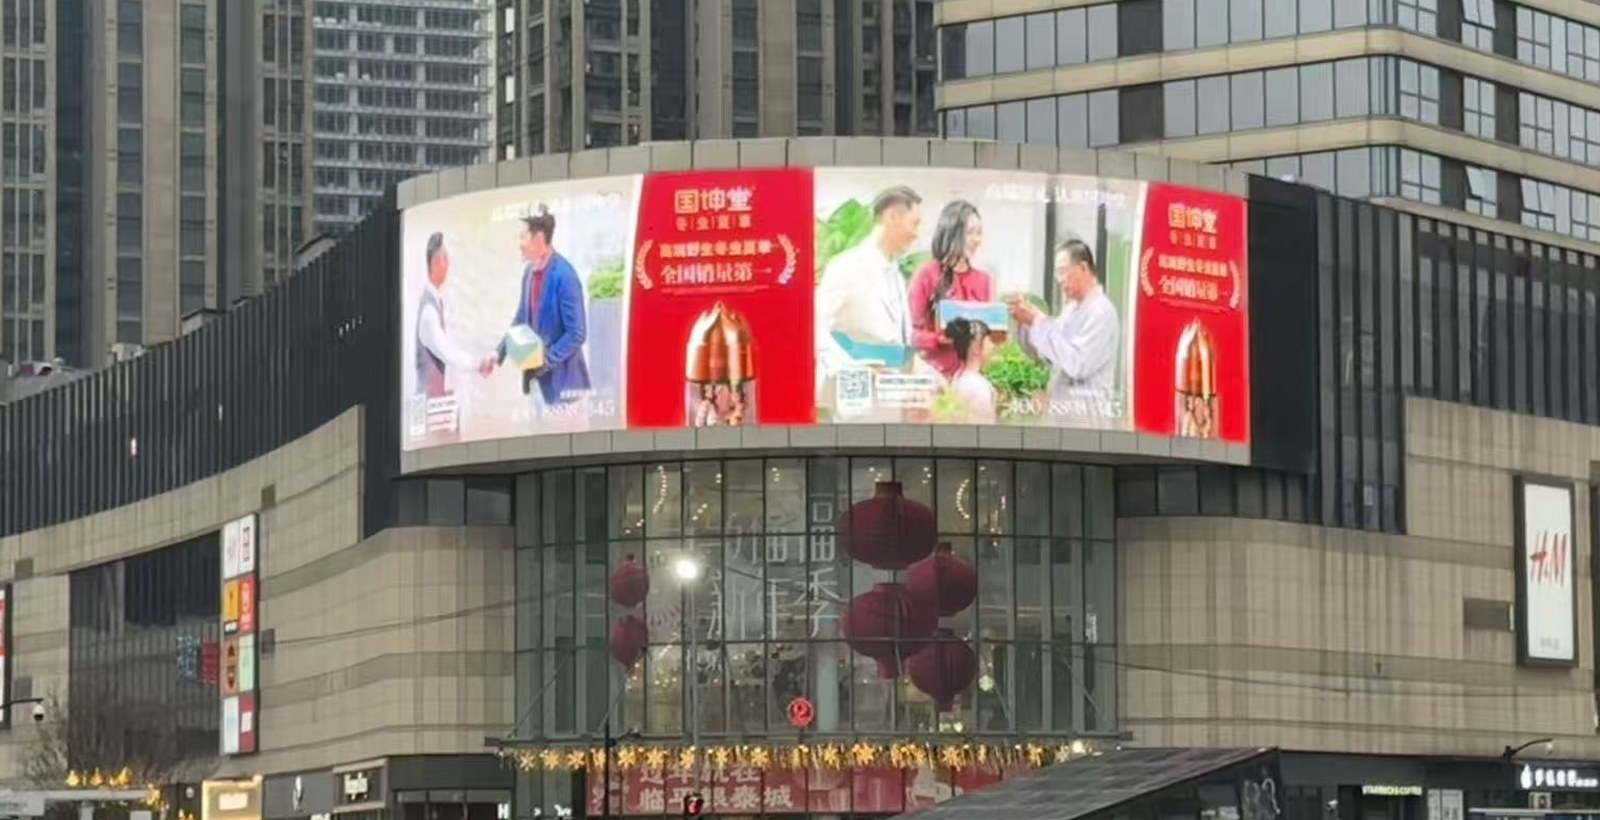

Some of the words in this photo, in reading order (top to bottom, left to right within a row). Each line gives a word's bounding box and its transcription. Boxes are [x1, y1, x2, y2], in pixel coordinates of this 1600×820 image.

[674, 186, 753, 214] 国坤堂
[660, 262, 772, 284] 全国销量第一
[1530, 529, 1568, 588] H&M
[639, 787, 794, 811] 临平银泰城
